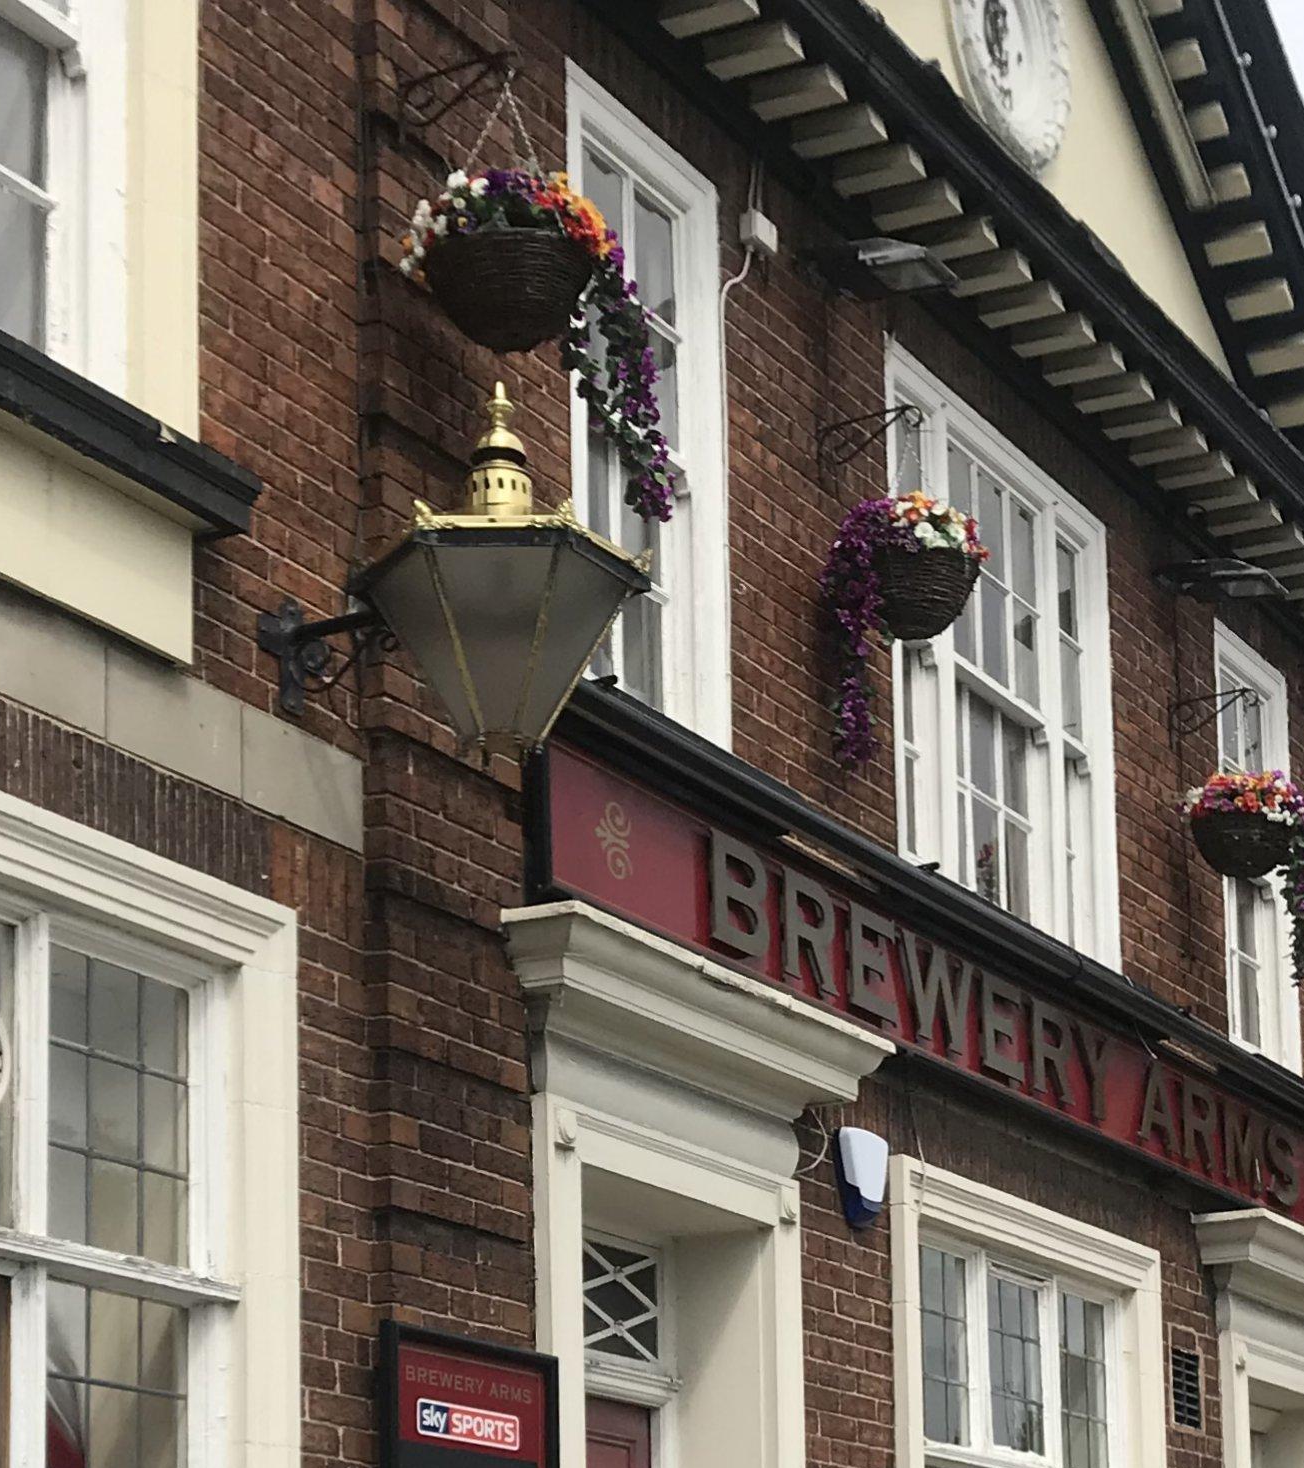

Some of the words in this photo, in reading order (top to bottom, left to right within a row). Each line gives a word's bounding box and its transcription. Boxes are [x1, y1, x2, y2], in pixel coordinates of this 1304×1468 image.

[710, 827, 1113, 1121] BREWERY
[1139, 1059, 1300, 1206] ARMS
[405, 1364, 485, 1395] BREWERY
[488, 1382, 533, 1405] ARMS
[422, 1404, 447, 1434] sky
[451, 1412, 515, 1443] SPORTS
